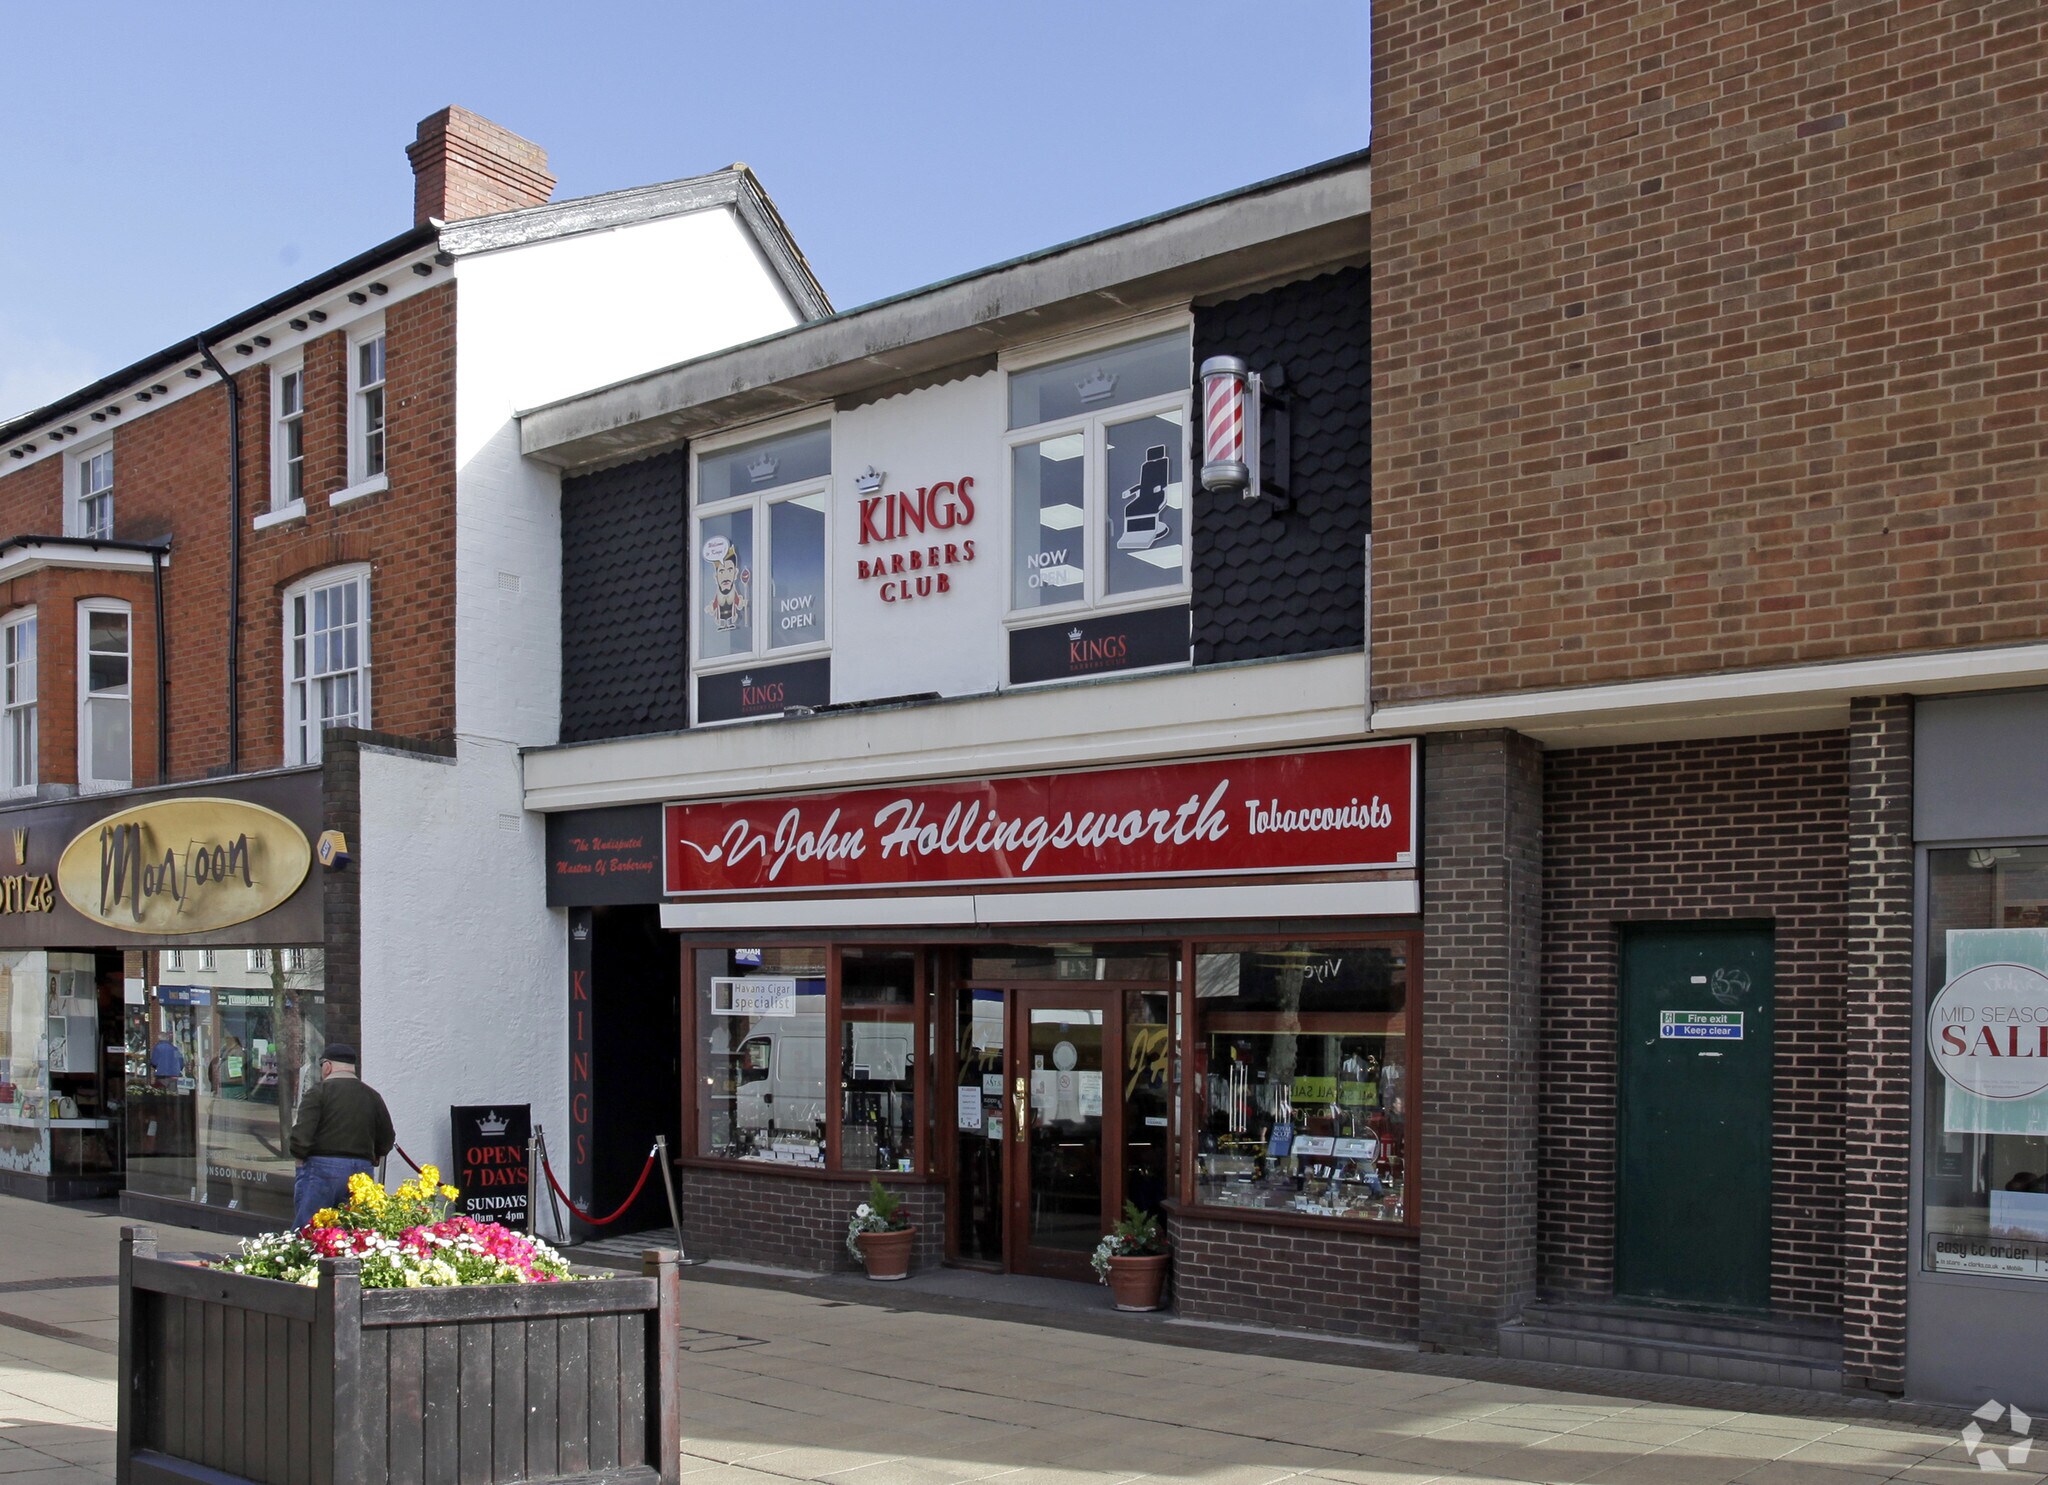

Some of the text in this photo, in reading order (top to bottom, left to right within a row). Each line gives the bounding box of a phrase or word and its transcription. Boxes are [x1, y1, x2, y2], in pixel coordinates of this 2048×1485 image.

[857, 476, 975, 545] KINGS
[857, 540, 975, 580] BARBERS
[1027, 549, 1068, 569] NOW
[879, 572, 951, 603] CLUB
[1028, 569, 1068, 589] OPEN
[781, 595, 812, 613] NOW
[781, 612, 813, 630] OPEN
[1070, 634, 1127, 663] KINGS
[742, 682, 784, 706] KINGS
[769, 779, 1393, 881] John Hollingsworth Tobacconists
[99, 822, 253, 923] Monsoon
[556, 859, 592, 874] Masters
[595, 858, 607, 876] Of
[735, 983, 790, 996] Havana Cigar
[735, 997, 790, 1012] specialist
[1688, 1014, 1728, 1023] Fire exit
[1941, 1006, 1975, 1023] MID
[1684, 1026, 1731, 1036] Keep clear
[572, 970, 589, 1166] KINGS
[467, 1146, 521, 1165] OPEN
[463, 1167, 528, 1187] 7 DAYS
[466, 1195, 527, 1211] SUNDAYS
[471, 1213, 494, 1222] 10am
[505, 1211, 525, 1222] 4pm
[1936, 1241, 2029, 1260] easy to order
